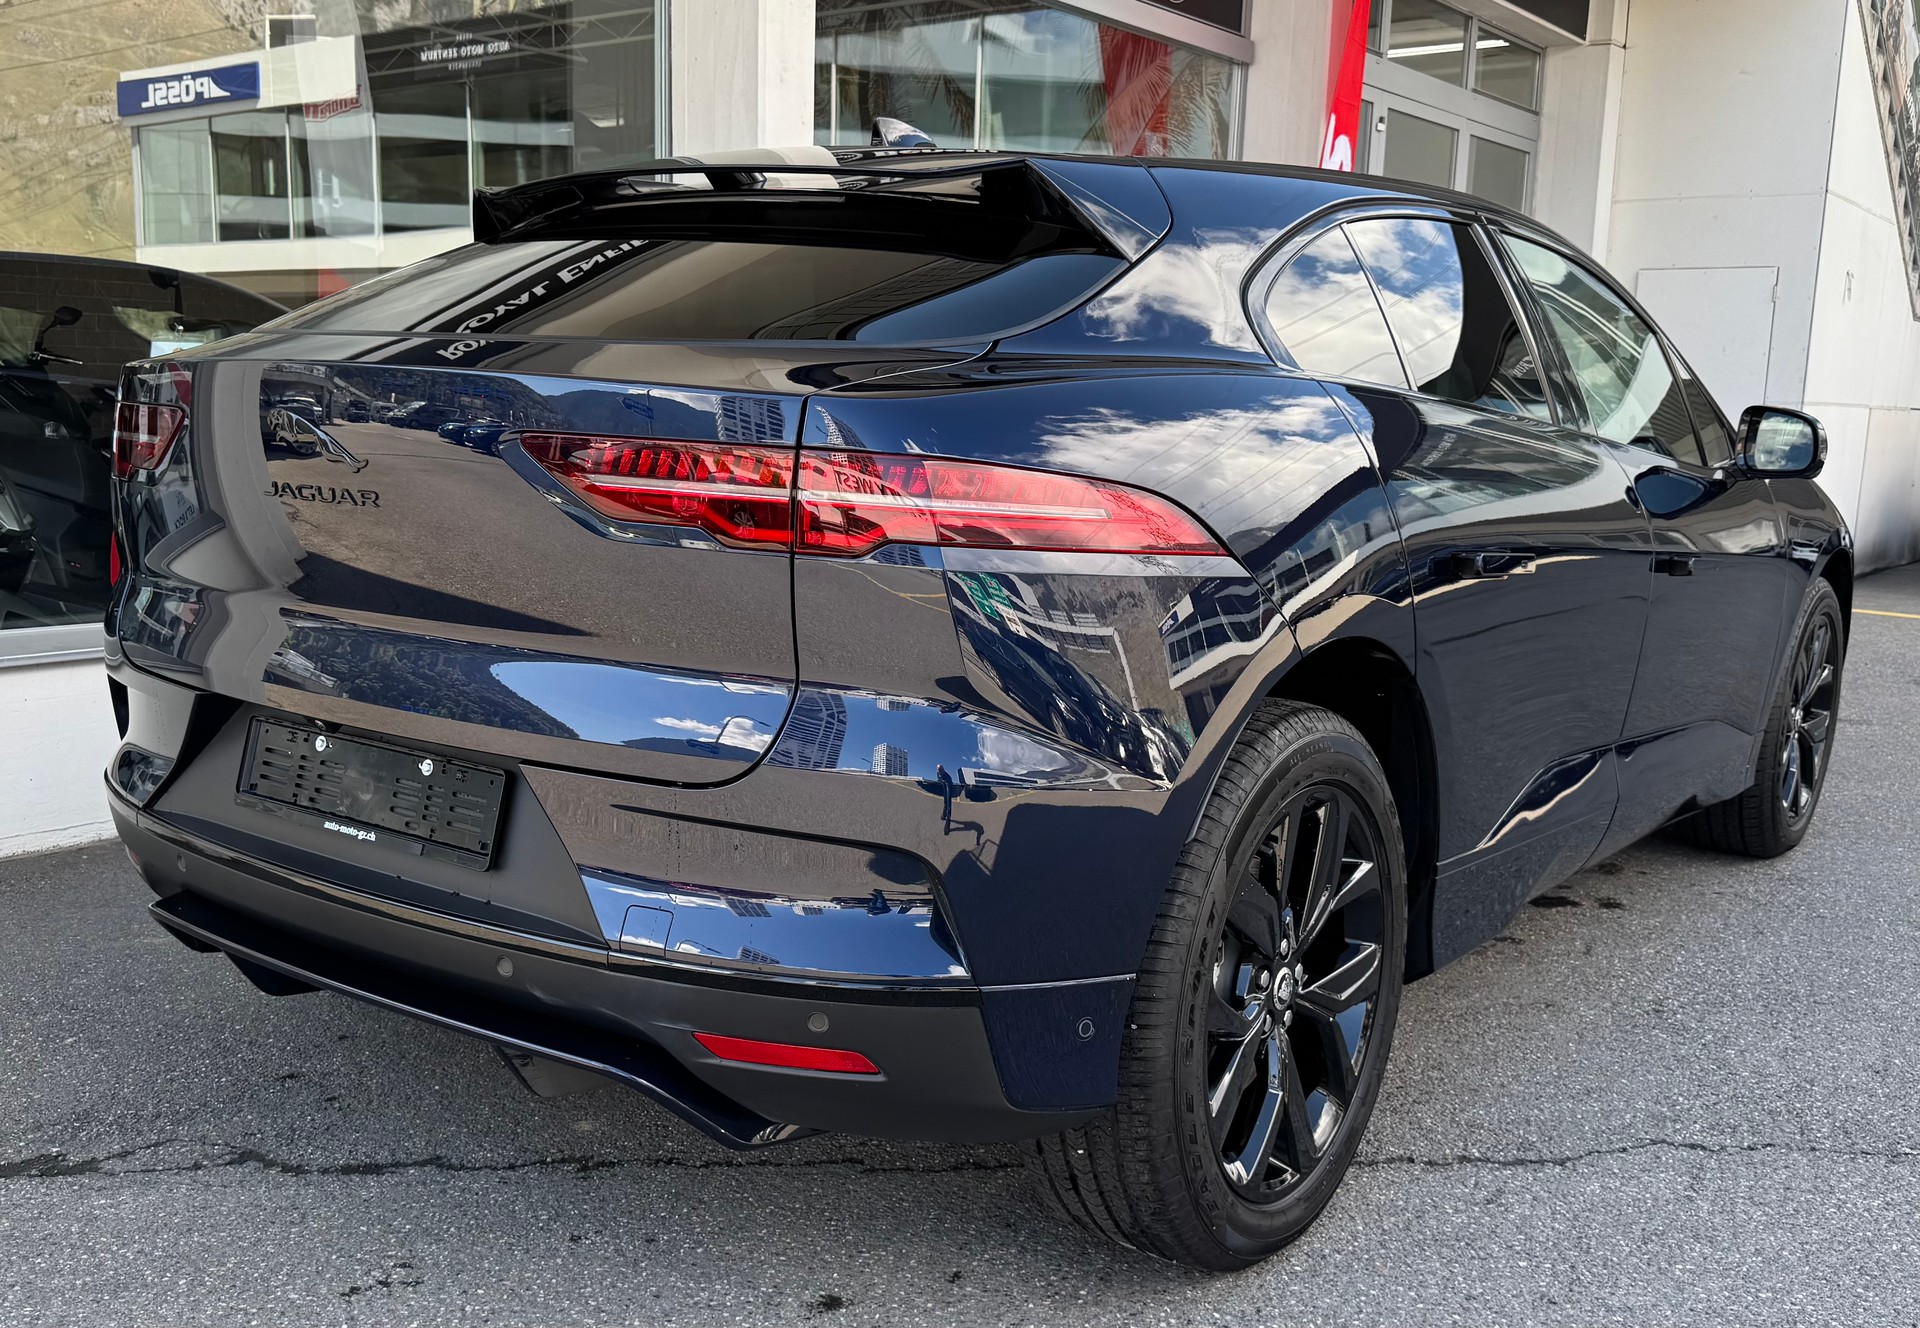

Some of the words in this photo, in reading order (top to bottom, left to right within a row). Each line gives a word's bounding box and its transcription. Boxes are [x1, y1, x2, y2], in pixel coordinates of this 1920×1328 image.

[264, 481, 380, 508] JAGUAR
[323, 821, 376, 842] auto-moto-gr.ch
[1184, 898, 1217, 1066] SPORT
[1185, 1090, 1220, 1216] EAGLE
